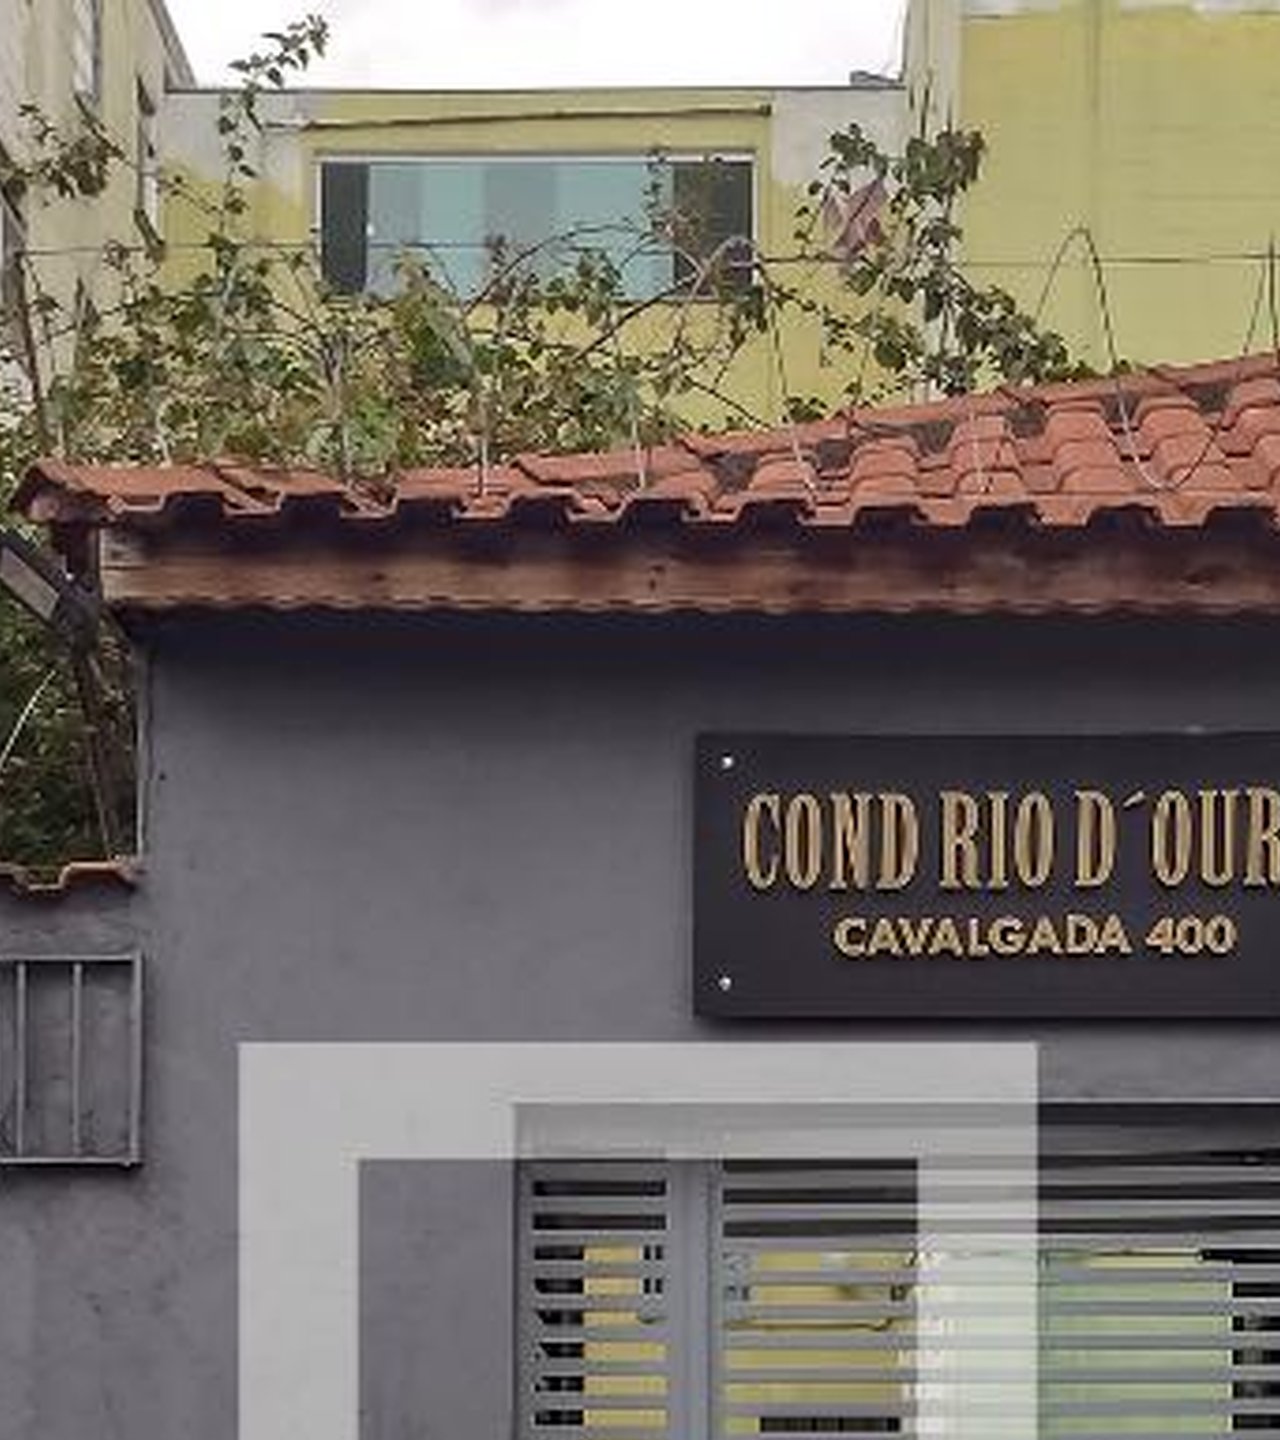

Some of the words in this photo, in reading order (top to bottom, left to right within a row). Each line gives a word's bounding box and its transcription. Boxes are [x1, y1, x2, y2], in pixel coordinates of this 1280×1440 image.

[741, 790, 920, 891] COND
[938, 789, 1056, 890] RIO
[832, 914, 1133, 958] CAVALGADA
[1145, 914, 1238, 956] 400
